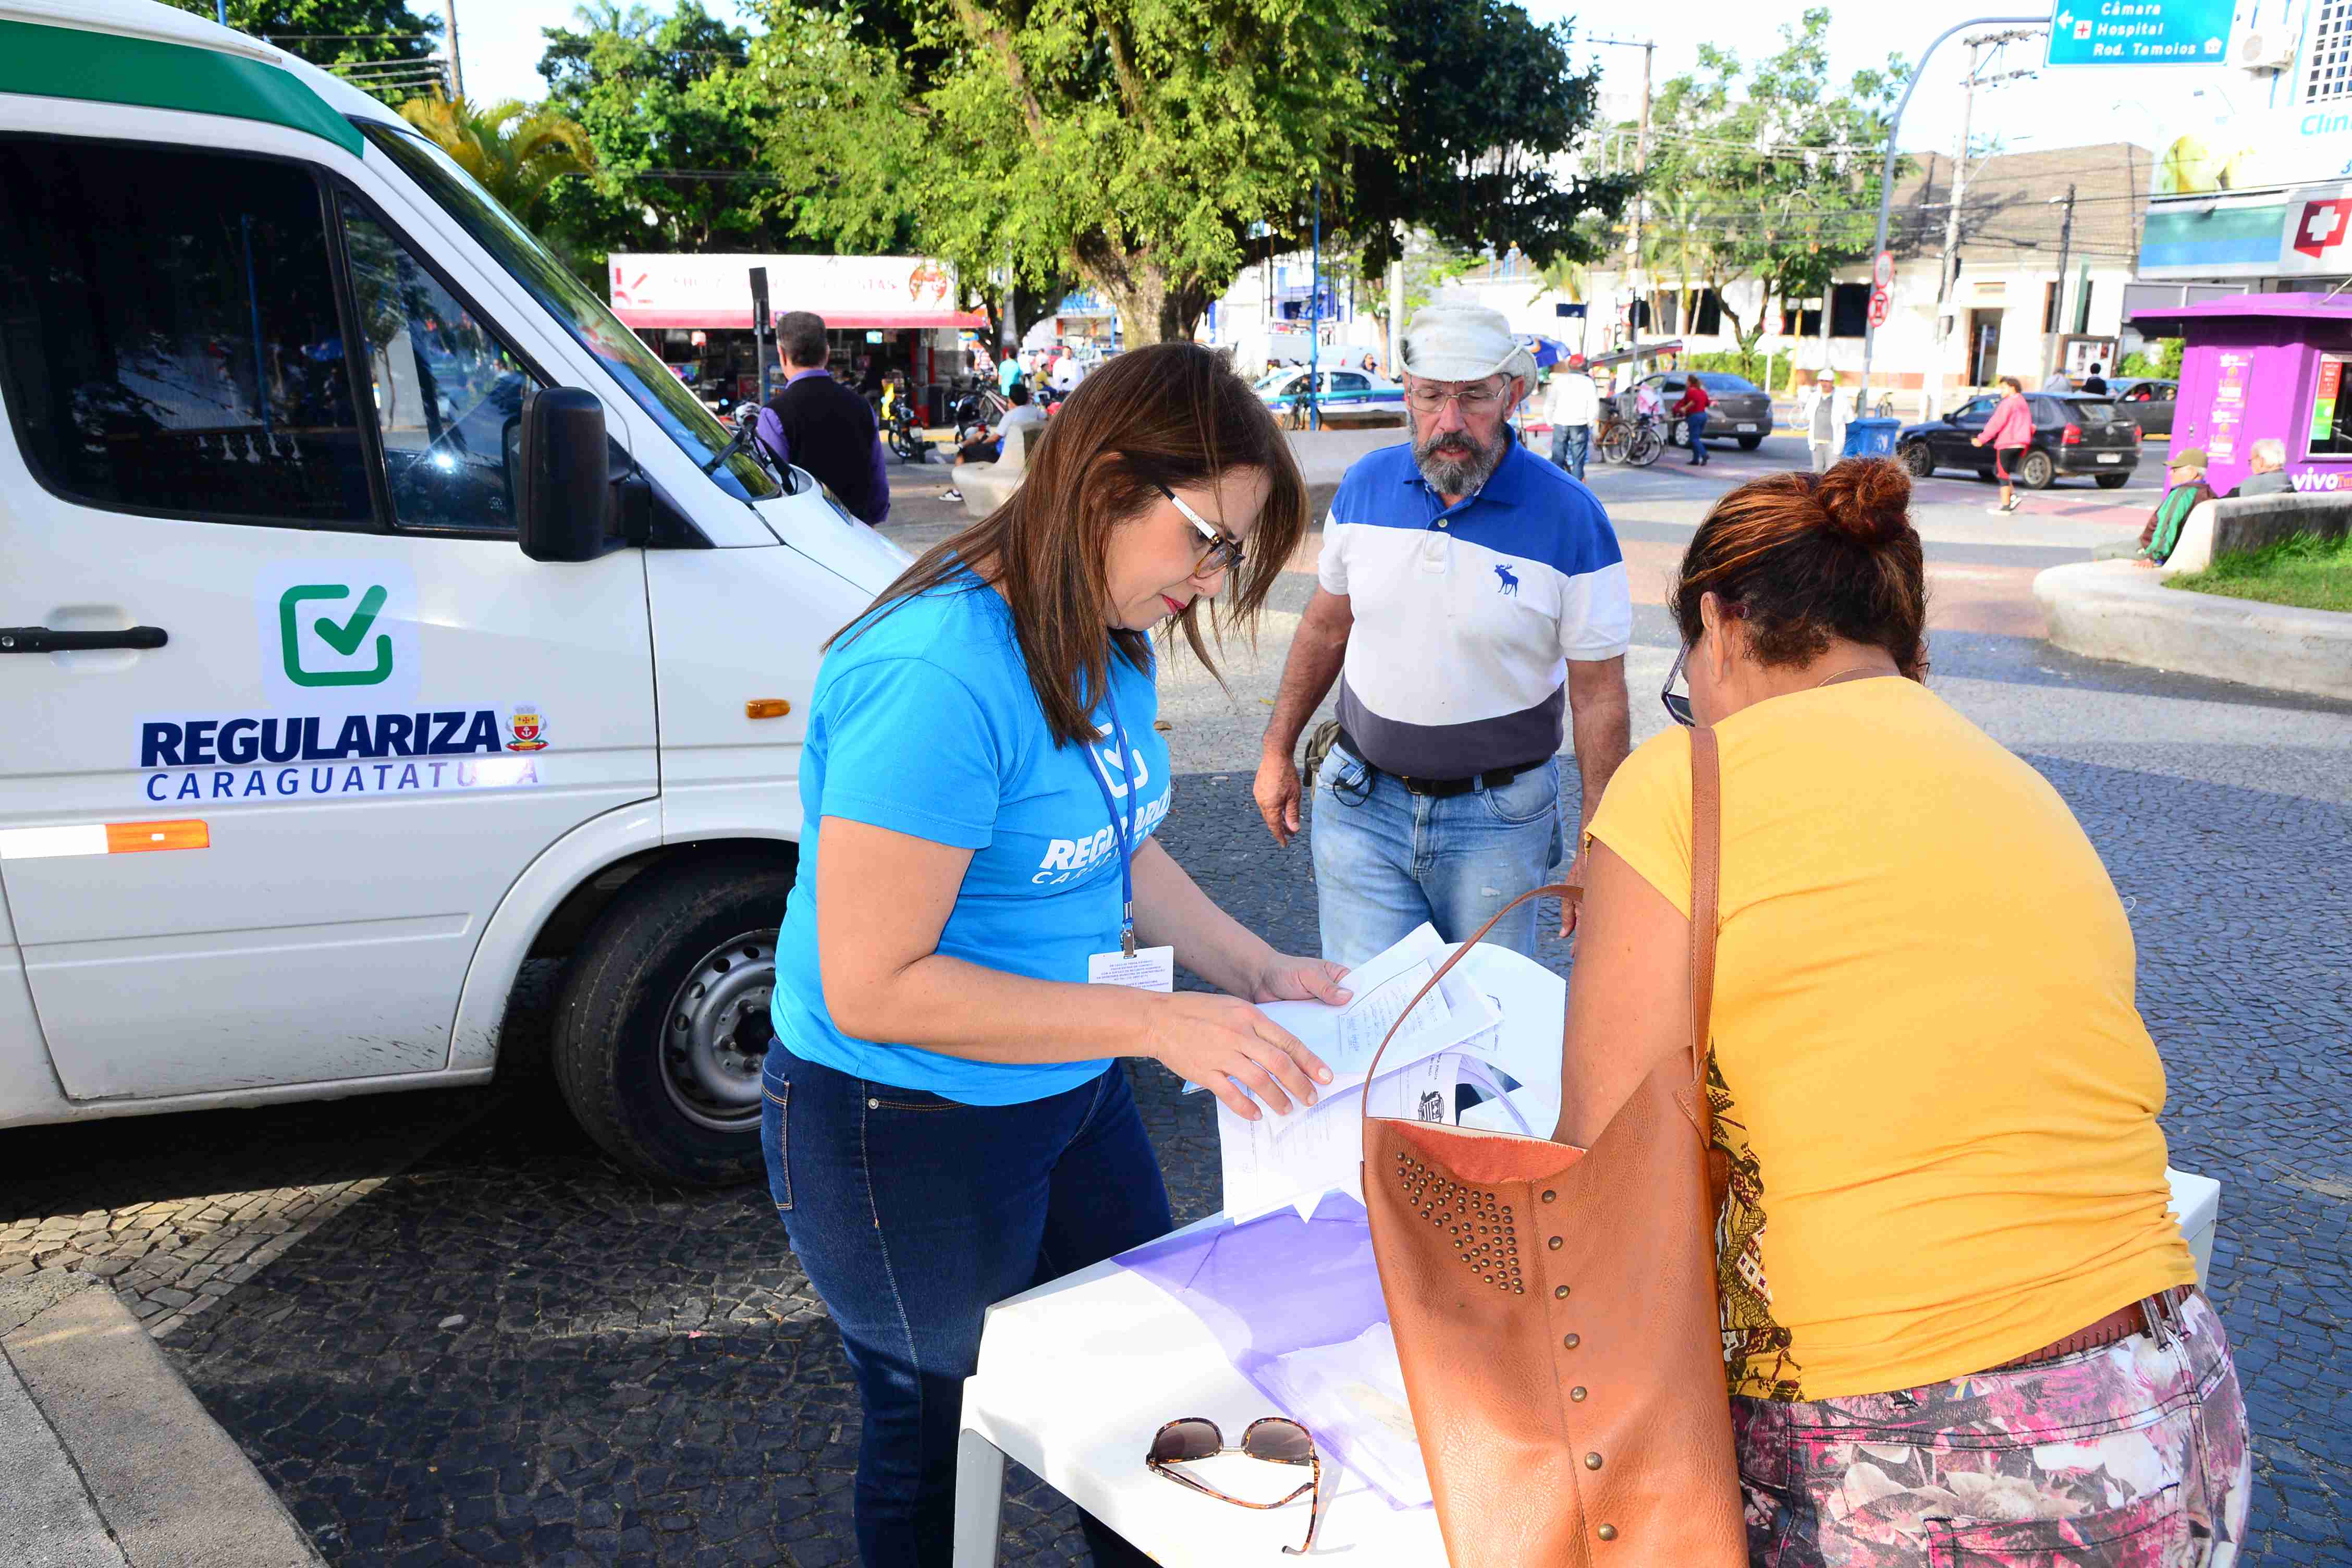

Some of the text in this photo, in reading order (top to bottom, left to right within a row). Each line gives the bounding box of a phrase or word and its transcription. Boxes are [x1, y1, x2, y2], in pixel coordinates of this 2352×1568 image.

[2101, 1, 2161, 16] Câmara
[2097, 22, 2164, 38] Hospital
[2093, 42, 2196, 56] Rod. Tamoios
[2292, 467, 2338, 491] vivo
[141, 710, 502, 767] REGULARIZA
[146, 759, 539, 801] CARAGUATATUA
